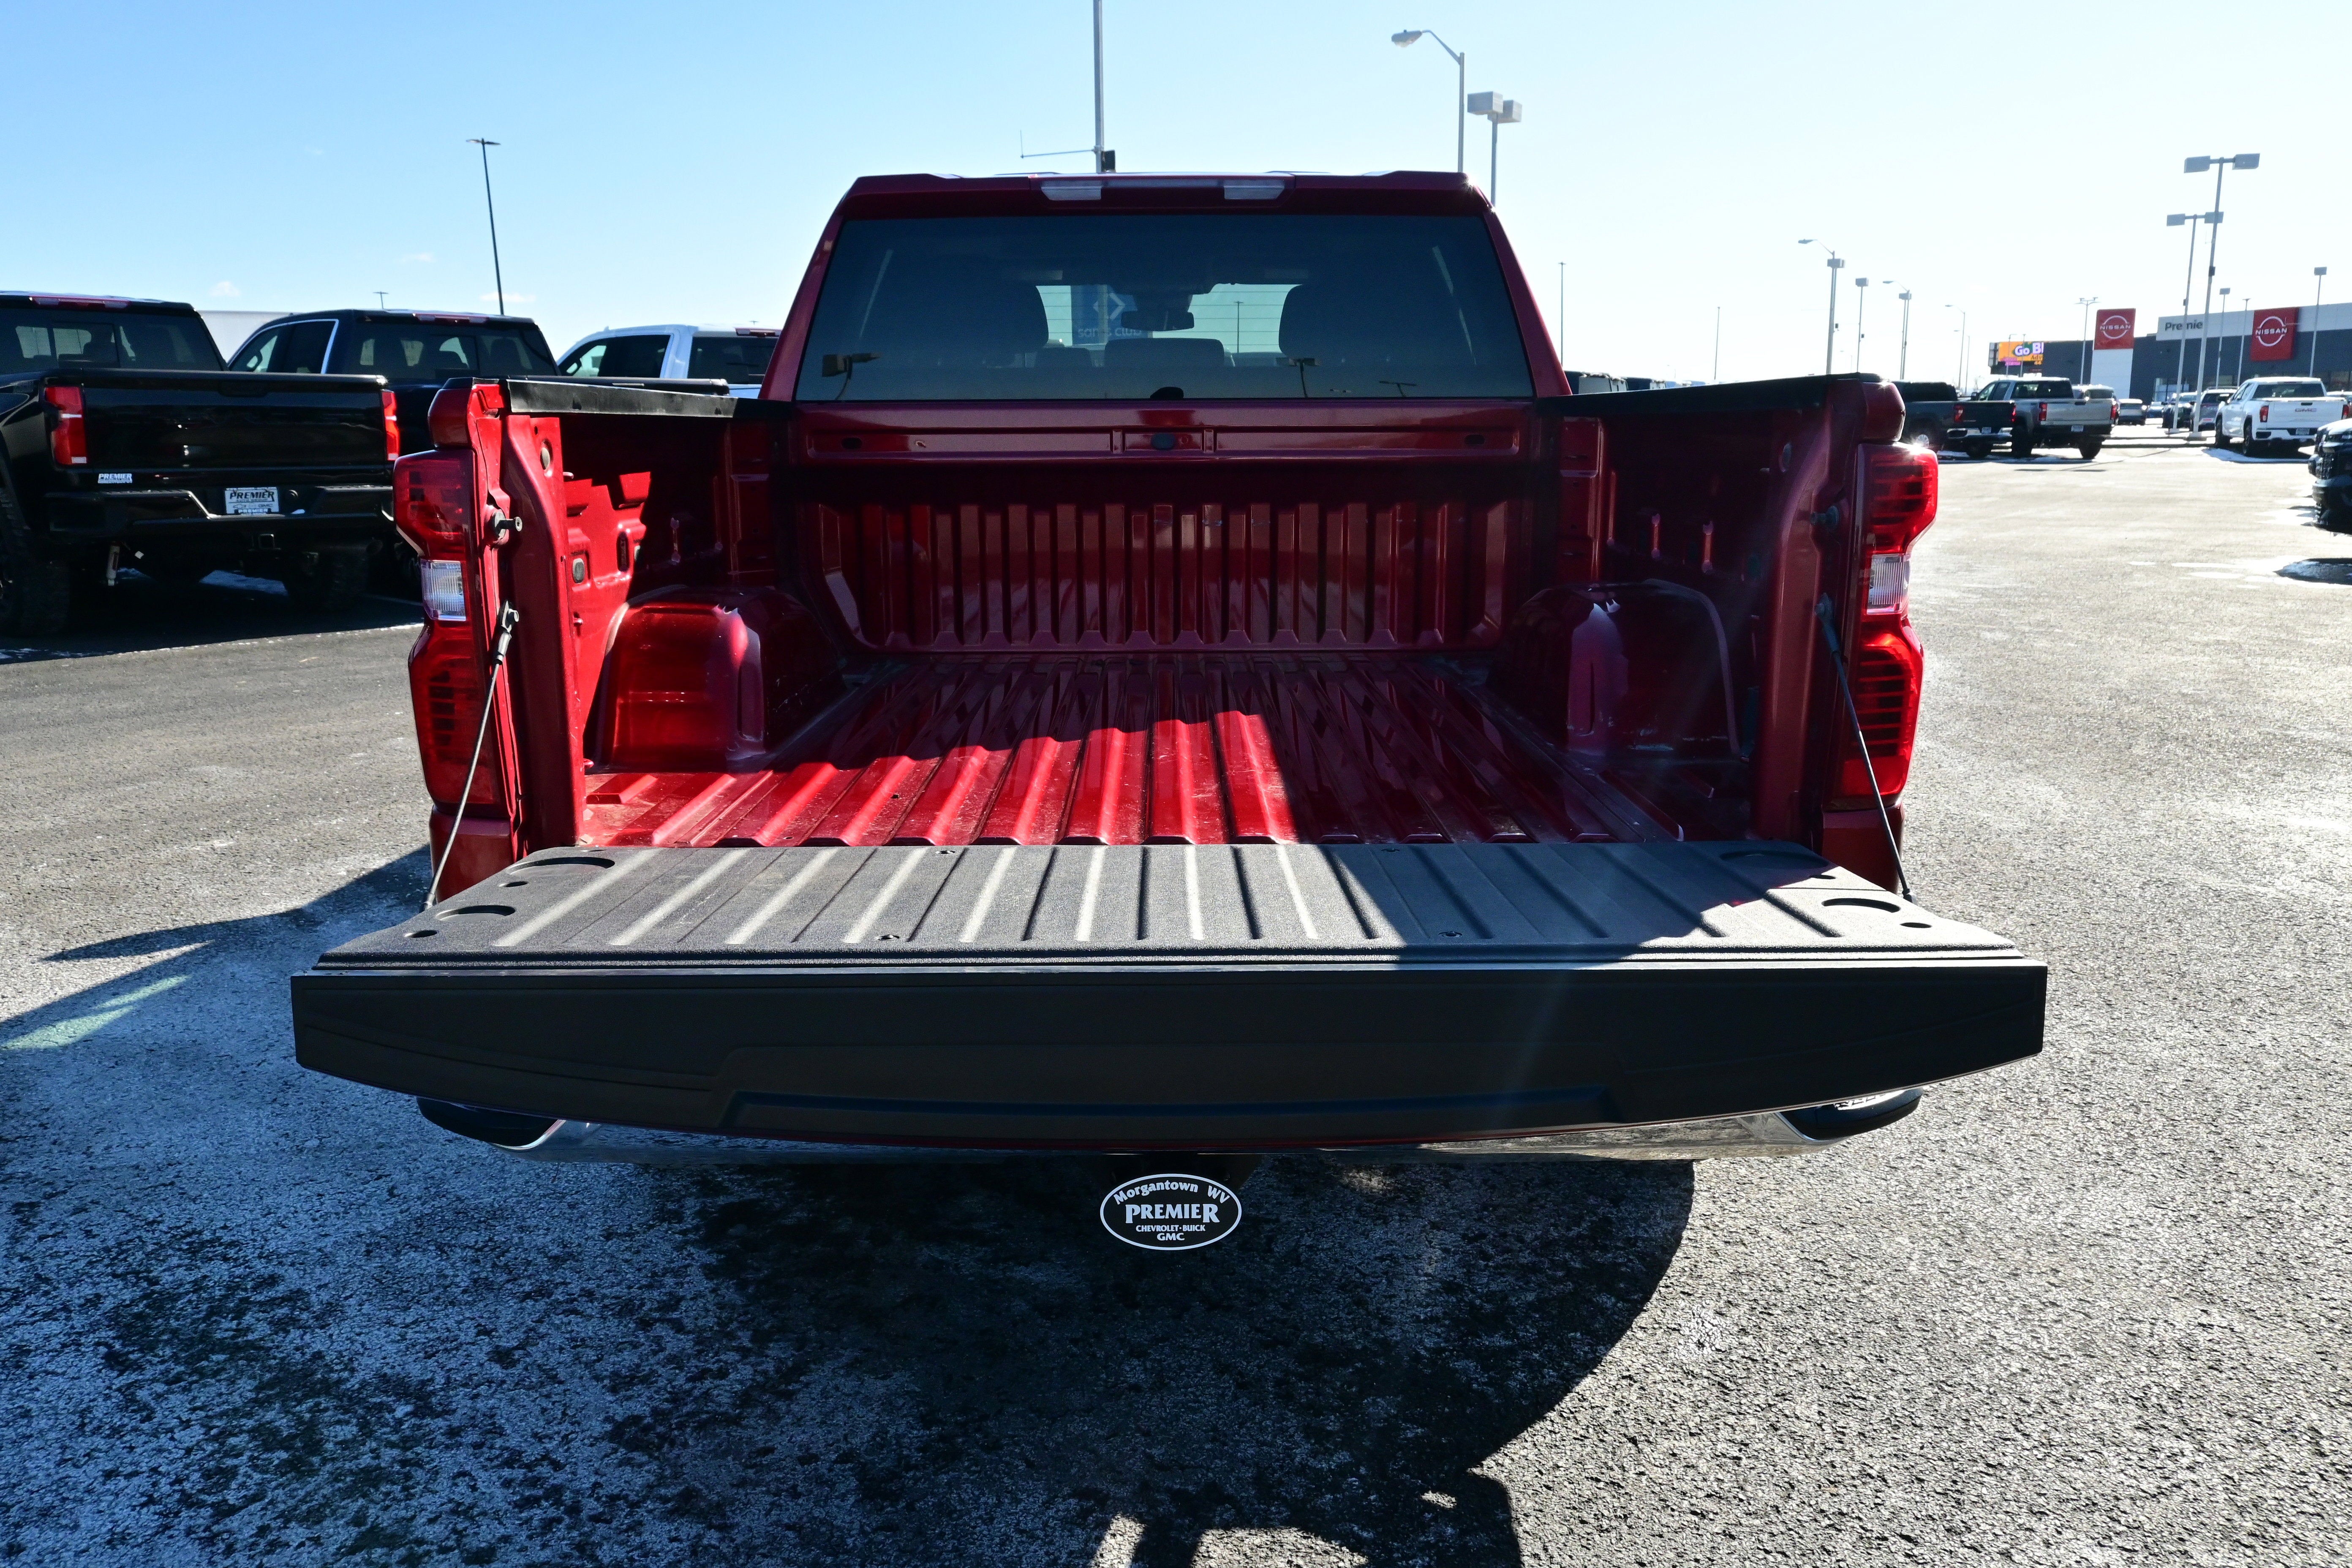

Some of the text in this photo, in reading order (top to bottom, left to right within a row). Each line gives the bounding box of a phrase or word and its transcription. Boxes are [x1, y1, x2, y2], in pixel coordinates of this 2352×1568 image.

[2165, 320, 2203, 331] Premie
[2014, 346, 2030, 356] Go
[98, 473, 132, 481] PREMIER
[230, 491, 275, 502] PREMIER
[1113, 1180, 1230, 1205] Morgantown WV
[1125, 1203, 1220, 1223] PREMIER
[1157, 1233, 1185, 1241] GMC
